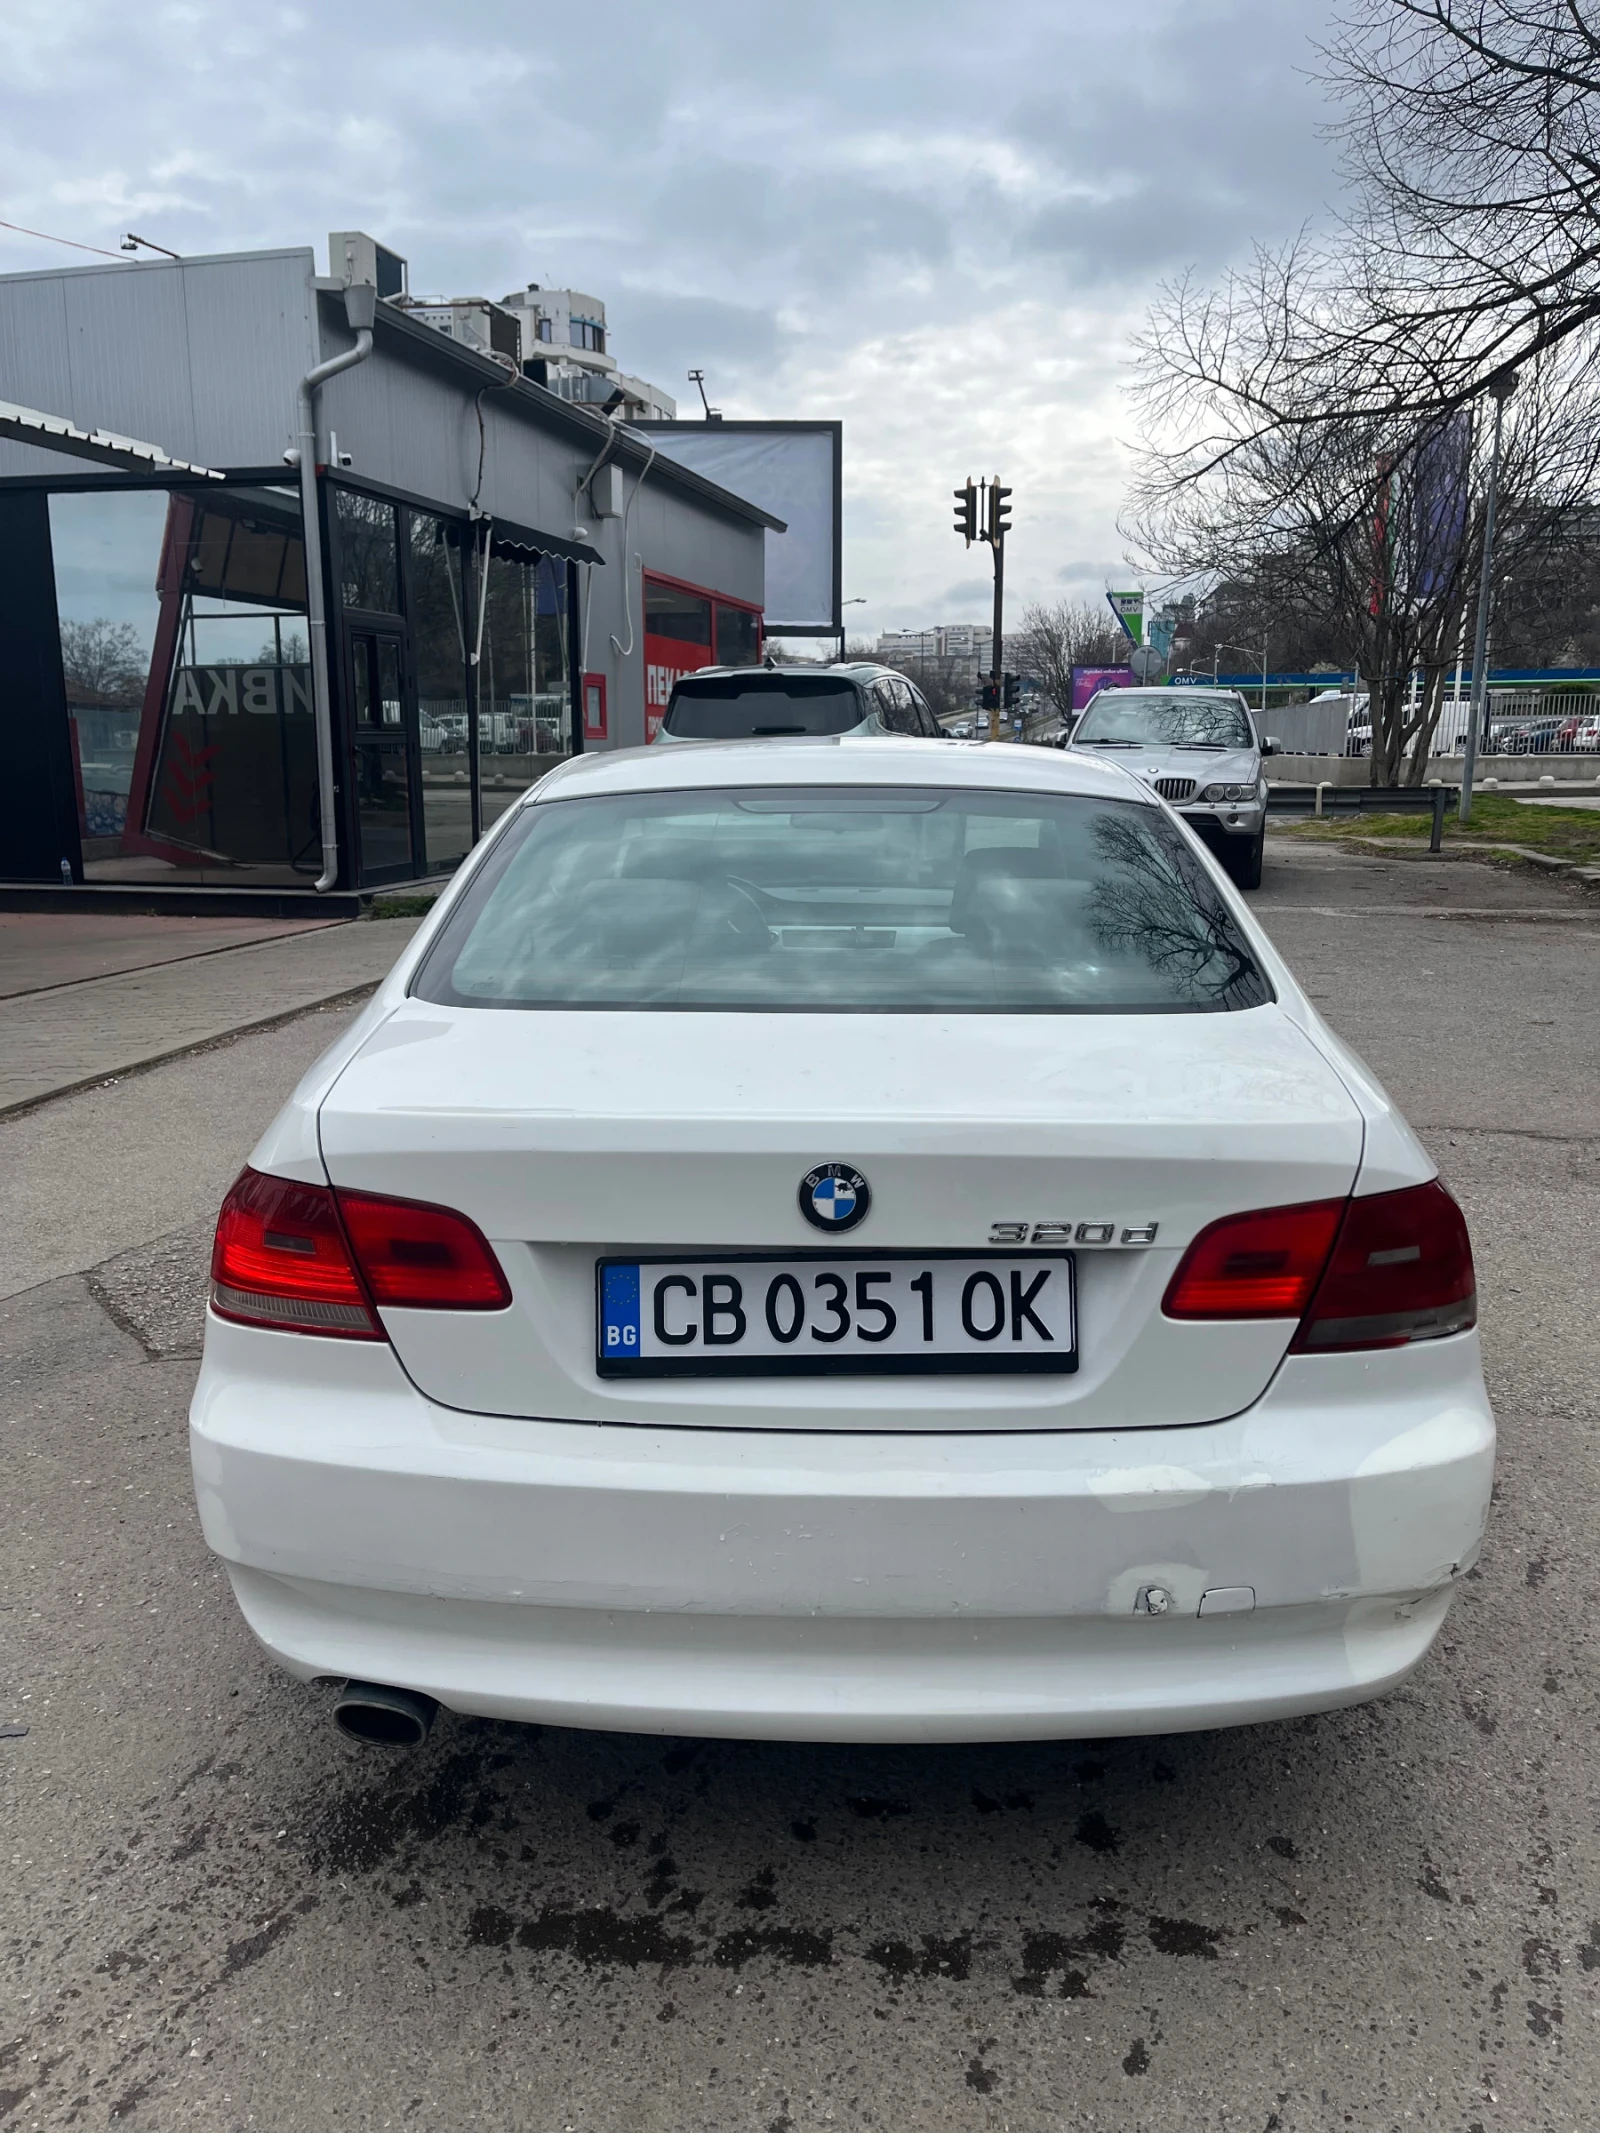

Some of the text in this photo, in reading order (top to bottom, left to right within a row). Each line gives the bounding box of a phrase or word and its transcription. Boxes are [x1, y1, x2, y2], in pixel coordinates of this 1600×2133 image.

[1174, 676, 1198, 685] OMV
[805, 1164, 865, 1189] BMW
[988, 1221, 1159, 1244] 320d
[653, 1269, 1055, 1345] CB 0351 OK
[607, 1325, 636, 1345] BG
